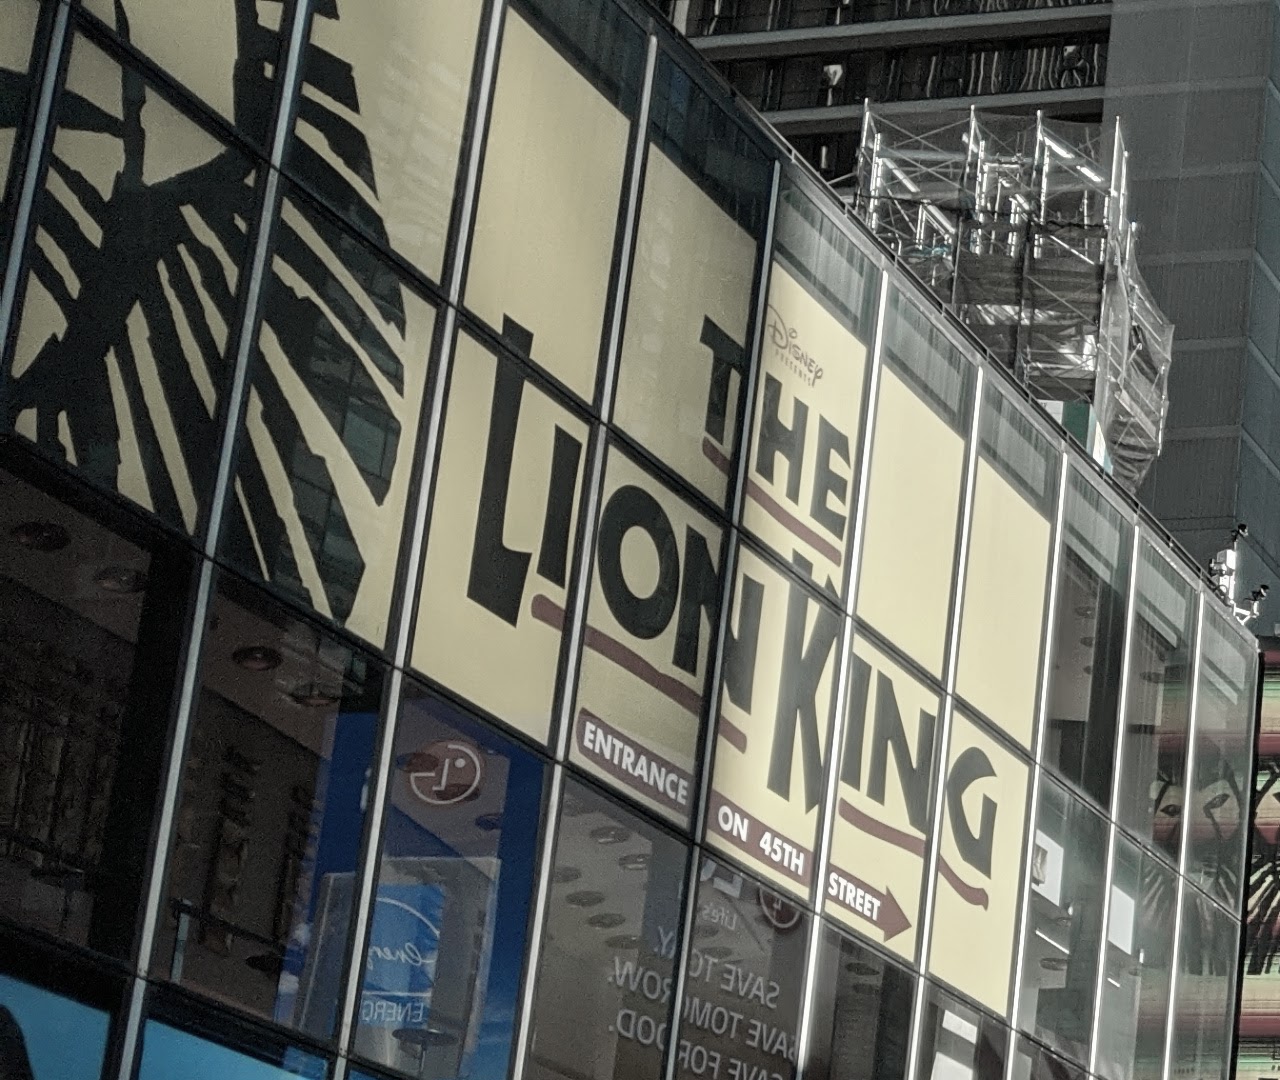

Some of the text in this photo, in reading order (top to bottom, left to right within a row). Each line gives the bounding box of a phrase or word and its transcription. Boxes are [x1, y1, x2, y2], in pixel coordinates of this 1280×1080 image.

[699, 315, 851, 540] THE
[767, 303, 823, 388] Disney
[467, 313, 765, 715] LION
[582, 720, 883, 922] ENTRANCE ON 45TH STREET
[767, 548, 997, 880] KING
